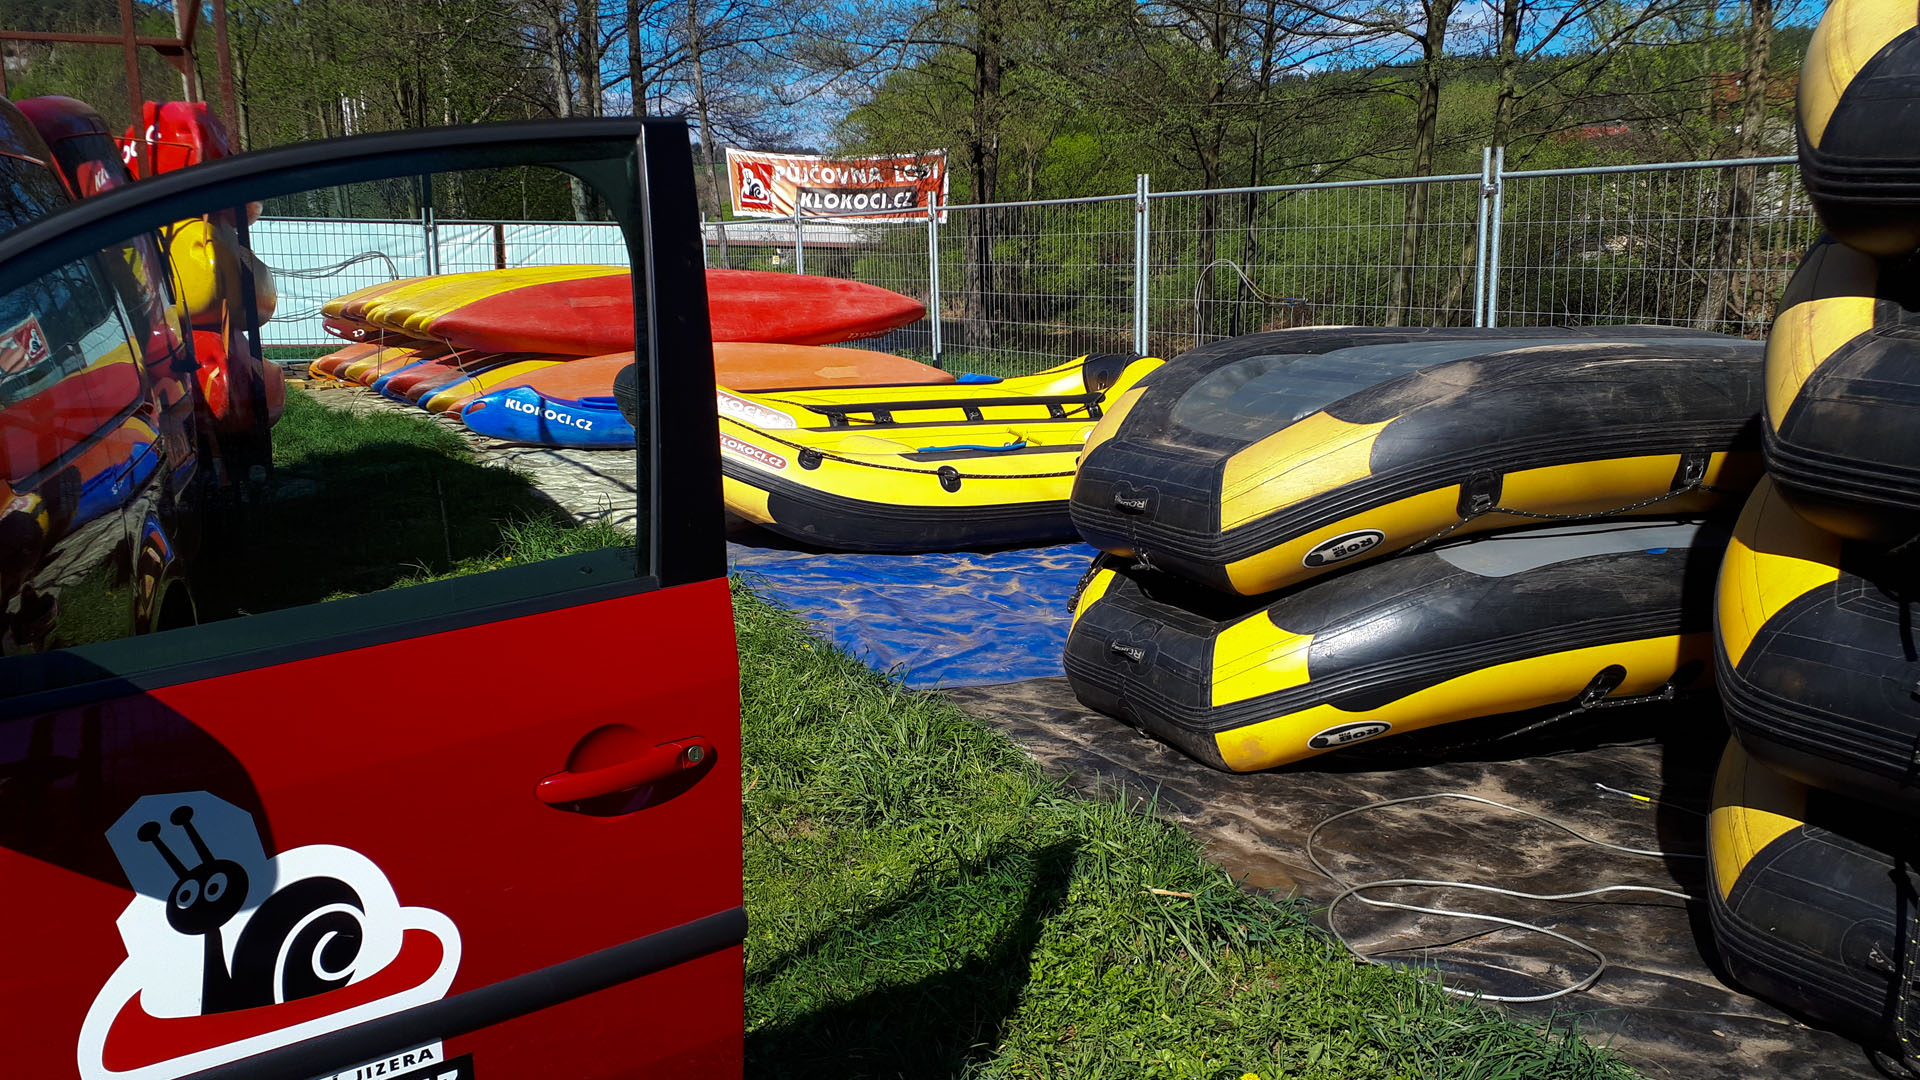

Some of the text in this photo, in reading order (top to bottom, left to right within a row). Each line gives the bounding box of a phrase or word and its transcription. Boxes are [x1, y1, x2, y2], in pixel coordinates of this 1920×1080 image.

[773, 163, 884, 184] PŮJČOVNA
[800, 191, 913, 210] KLOKOCI.CZ
[504, 398, 593, 431] KLOKOCI.CZ
[1333, 537, 1374, 558] ROB
[355, 1048, 434, 1080] JIZERA
